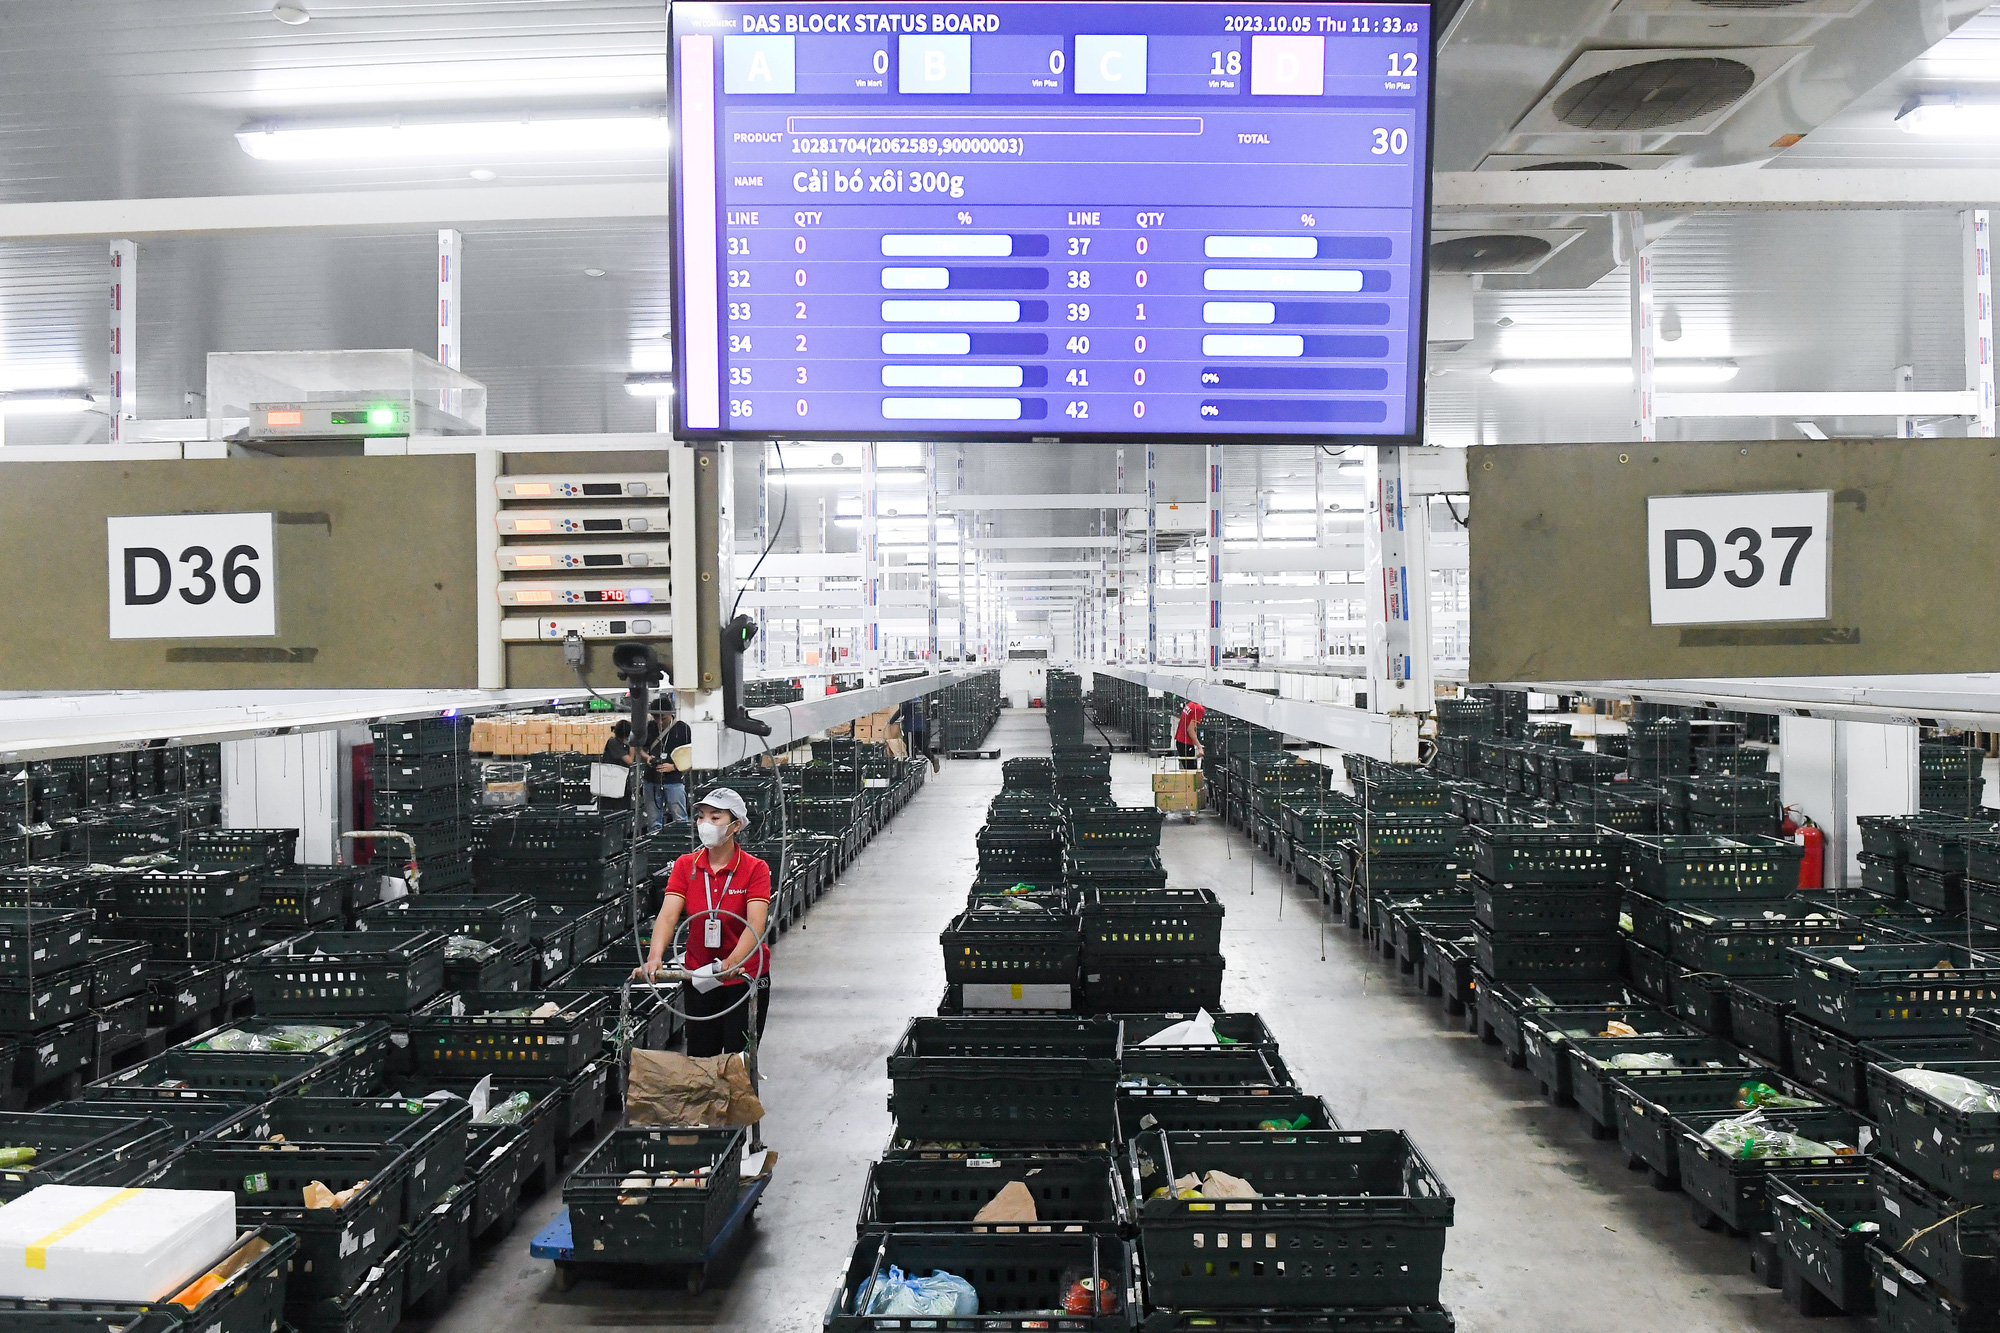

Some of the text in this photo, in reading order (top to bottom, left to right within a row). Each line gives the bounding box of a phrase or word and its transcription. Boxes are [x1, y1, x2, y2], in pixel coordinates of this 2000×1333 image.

[742, 14, 1000, 32] DAS BLOCK STATUS BOARD
[1225, 16, 1311, 32] 2023.10.05
[1317, 16, 1347, 32] Thu
[747, 51, 772, 81] A
[873, 49, 889, 74] 0
[924, 51, 947, 81] B
[1049, 49, 1065, 74] 0
[1100, 51, 1122, 82] C
[1210, 50, 1242, 75] 18
[1276, 52, 1298, 82] D
[1387, 52, 1418, 77] 12
[855, 79, 865, 87] Vin
[1032, 79, 1058, 88] Vin Plus
[1208, 79, 1235, 88] Vin Plus
[1384, 81, 1411, 90] Vin Plus
[733, 132, 783, 143] PRODUCT
[1237, 133, 1270, 144] TOTAL
[1371, 128, 1408, 155] 30
[791, 138, 1024, 156] 10281704(2062589,90000003)
[734, 176, 763, 187] NAME
[793, 168, 964, 198] Cải bó xôi 300g
[727, 212, 759, 225] LINE
[794, 212, 822, 227] QTY
[957, 211, 973, 225] %
[1068, 212, 1100, 226] LINE
[1136, 212, 1164, 227] QTY
[1301, 213, 1316, 227] %
[727, 237, 751, 255] 31
[795, 236, 807, 254] 0
[1067, 237, 1091, 256] 37
[1136, 236, 1148, 255] 0
[728, 270, 751, 288] 32
[795, 269, 807, 287] 0
[1067, 270, 1090, 289] 38
[1135, 269, 1148, 288] 0
[728, 303, 751, 321] 33
[795, 302, 807, 320] 2
[1066, 303, 1090, 321] 39
[1135, 303, 1147, 321] 1
[729, 335, 752, 353] 34
[795, 334, 807, 352] 2
[1066, 336, 1090, 354] 40
[1134, 335, 1147, 354] 0
[729, 368, 752, 386] 35
[796, 366, 808, 384] 3
[1065, 369, 1089, 386] 41
[1134, 368, 1146, 386] 0
[1201, 372, 1220, 384] 0%
[730, 400, 753, 417] 36
[796, 399, 808, 417] 0
[1065, 401, 1089, 418] 42
[1133, 400, 1146, 418] 0
[1200, 405, 1219, 417] 0%
[1664, 526, 1813, 590] D37
[124, 545, 261, 605] D36
[601, 590, 623, 601] 370
